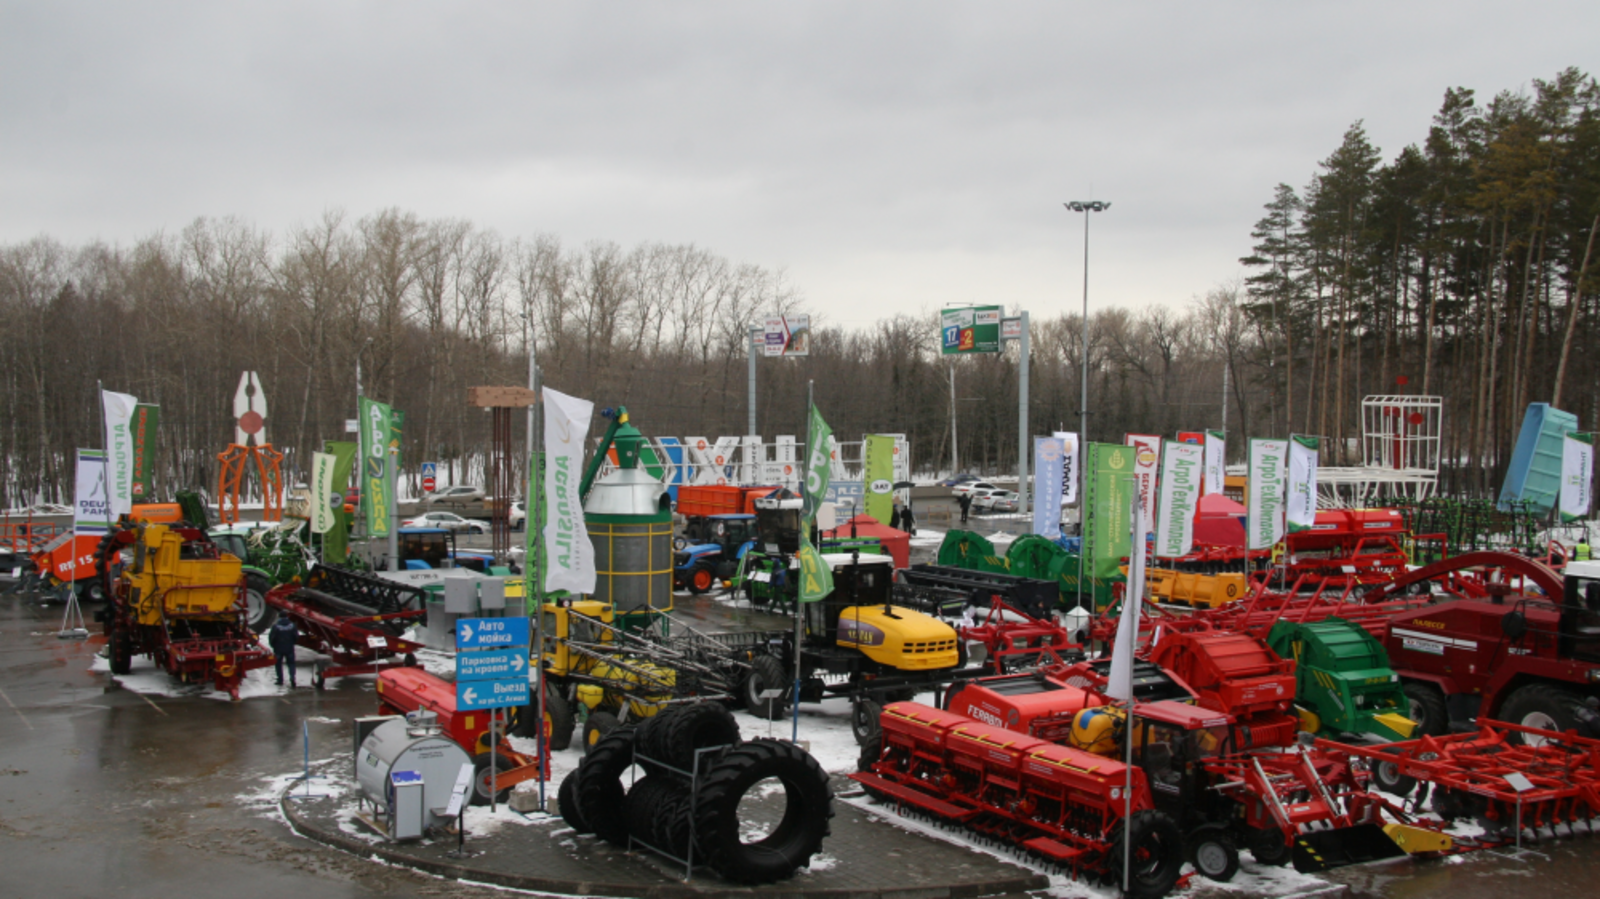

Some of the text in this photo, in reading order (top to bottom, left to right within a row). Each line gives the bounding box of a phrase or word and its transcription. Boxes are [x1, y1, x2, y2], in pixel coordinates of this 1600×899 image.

[946, 327, 958, 343] 17
[369, 403, 384, 458] АГРО
[370, 477, 387, 533] СИЛА
[478, 620, 505, 632] Авто
[478, 632, 512, 644] мойка
[461, 655, 508, 666] Парковка
[461, 666, 473, 675] на
[493, 682, 526, 694] Выезд
[478, 697, 486, 705] на
